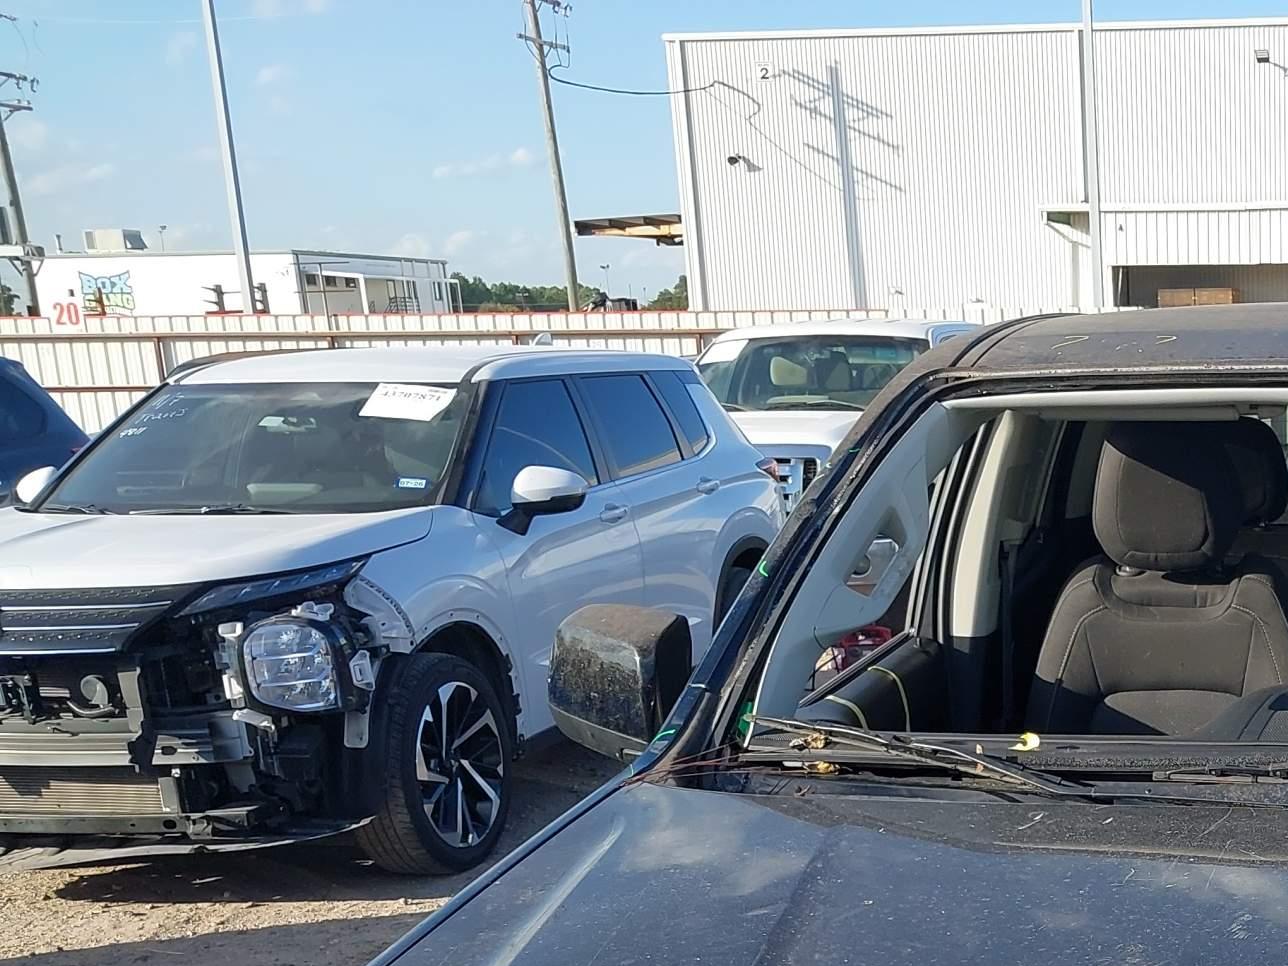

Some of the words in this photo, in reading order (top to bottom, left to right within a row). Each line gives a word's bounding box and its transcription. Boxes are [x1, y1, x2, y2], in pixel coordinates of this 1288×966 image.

[760, 67, 770, 80] 2
[79, 270, 133, 294] BOX
[53, 303, 81, 325] 20
[399, 480, 424, 488] 07-26
